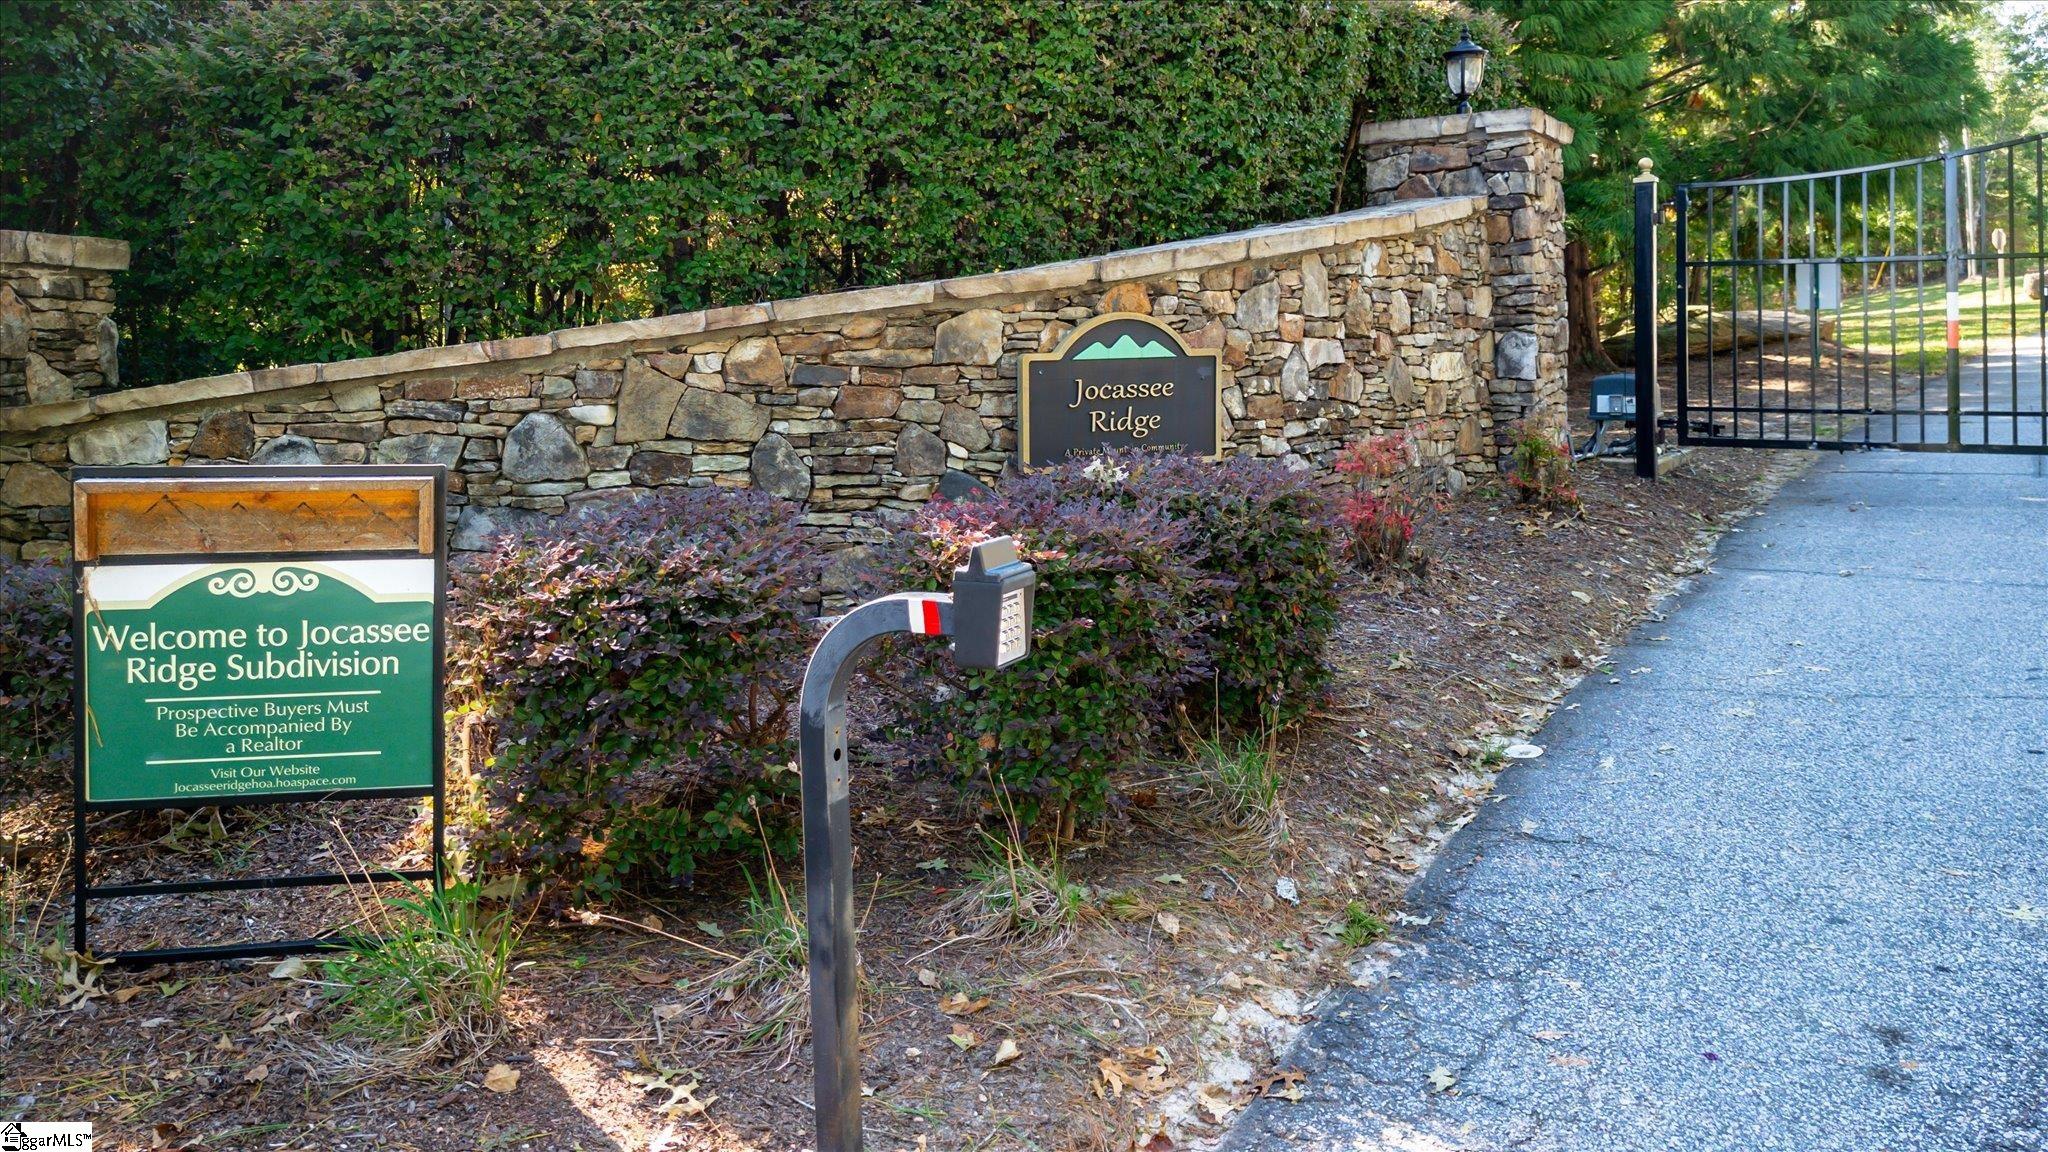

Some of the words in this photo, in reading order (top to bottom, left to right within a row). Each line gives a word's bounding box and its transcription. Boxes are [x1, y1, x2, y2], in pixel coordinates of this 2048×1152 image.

[1068, 378, 1174, 408] Jocassee
[1089, 406, 1161, 438] Ridge
[1064, 448, 1071, 457] A
[1073, 446, 1101, 457] Private
[92, 621, 247, 651] Welcome
[256, 623, 288, 647] to
[297, 619, 430, 650] Jocassee
[126, 653, 217, 691] Ridge
[226, 650, 400, 680] Subdivision
[157, 703, 259, 723] Prospective
[264, 702, 322, 720] Buyers
[327, 700, 369, 714] Must
[175, 723, 198, 738] Be
[204, 717, 325, 738] Accompanied
[331, 717, 352, 735] By
[225, 743, 236, 754] a
[241, 736, 303, 752] Realtor
[210, 767, 237, 779] Visit
[241, 766, 265, 778] Our
[269, 764, 321, 777] Website
[174, 775, 357, 794] Jocasseeridgehoa.hoaspace.com
